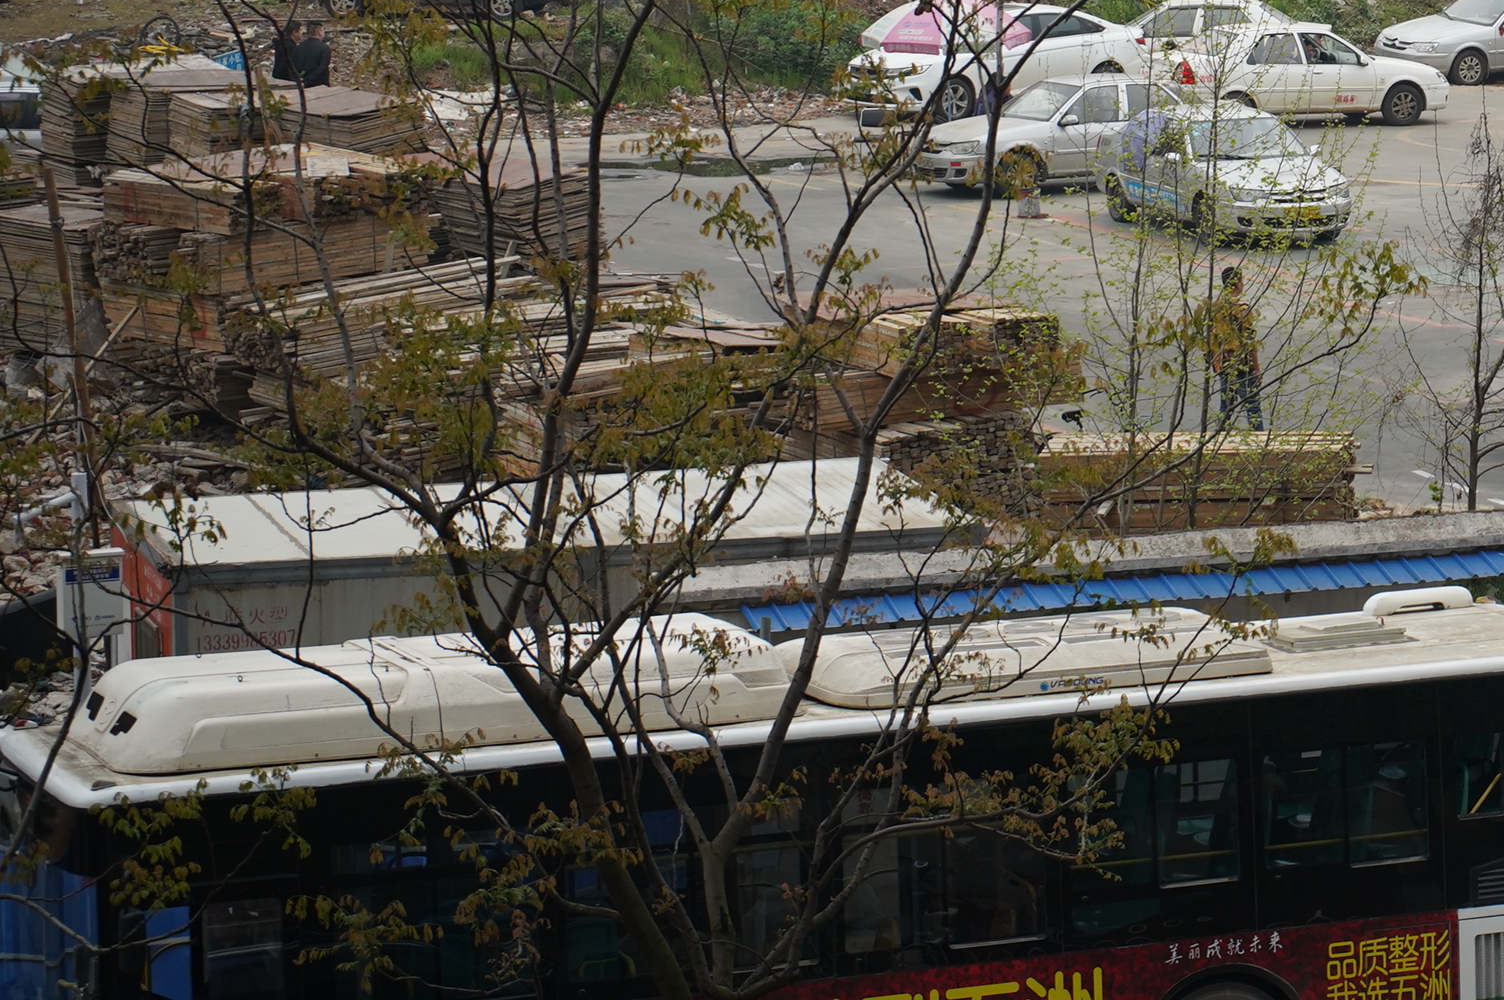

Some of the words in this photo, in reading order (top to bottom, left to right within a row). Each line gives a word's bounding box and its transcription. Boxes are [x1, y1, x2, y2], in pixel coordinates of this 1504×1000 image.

[1164, 931, 1284, 965] 美丽成就未来
[1326, 929, 1450, 981] 品质整形
